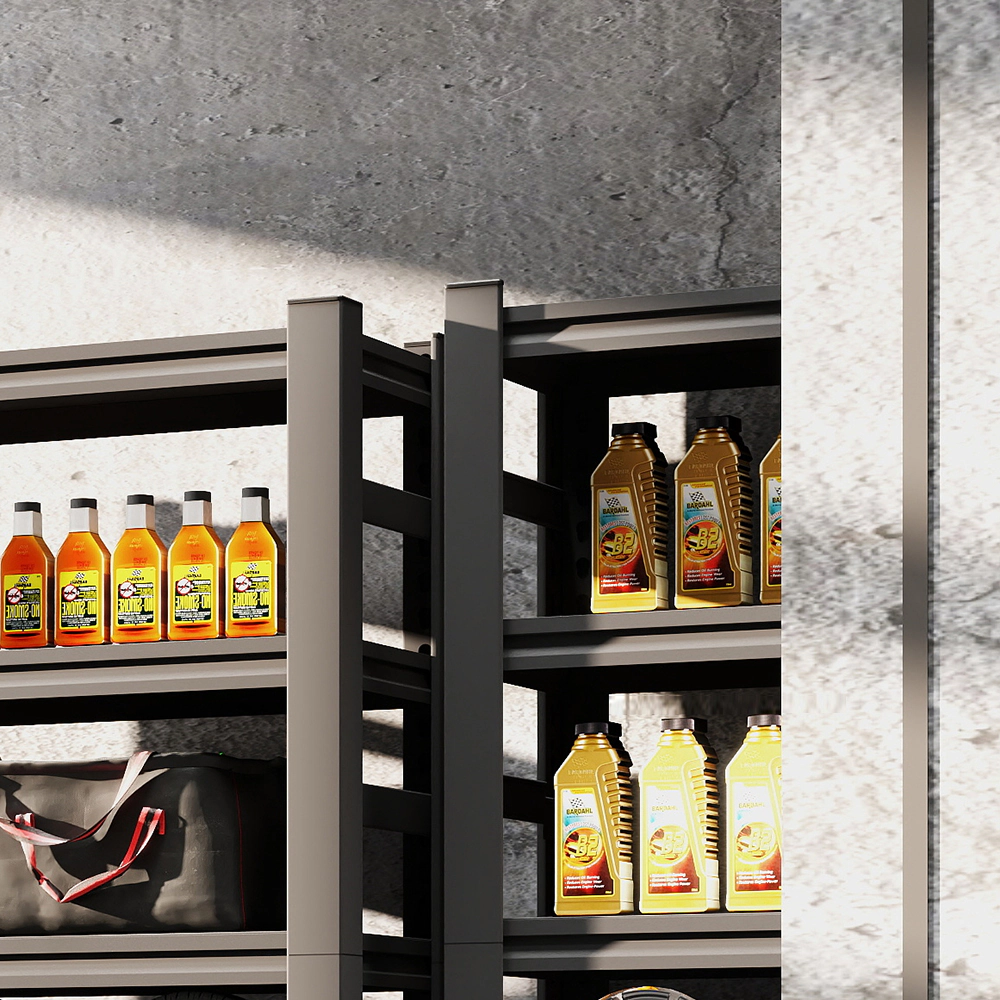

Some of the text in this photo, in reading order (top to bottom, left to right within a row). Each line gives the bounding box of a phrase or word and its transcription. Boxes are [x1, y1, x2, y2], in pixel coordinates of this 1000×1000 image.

[602, 506, 629, 514] BARDAHL
[687, 501, 713, 509] BARDAHL
[613, 533, 635, 555] B2
[697, 527, 719, 549] B2
[576, 834, 599, 857] B2
